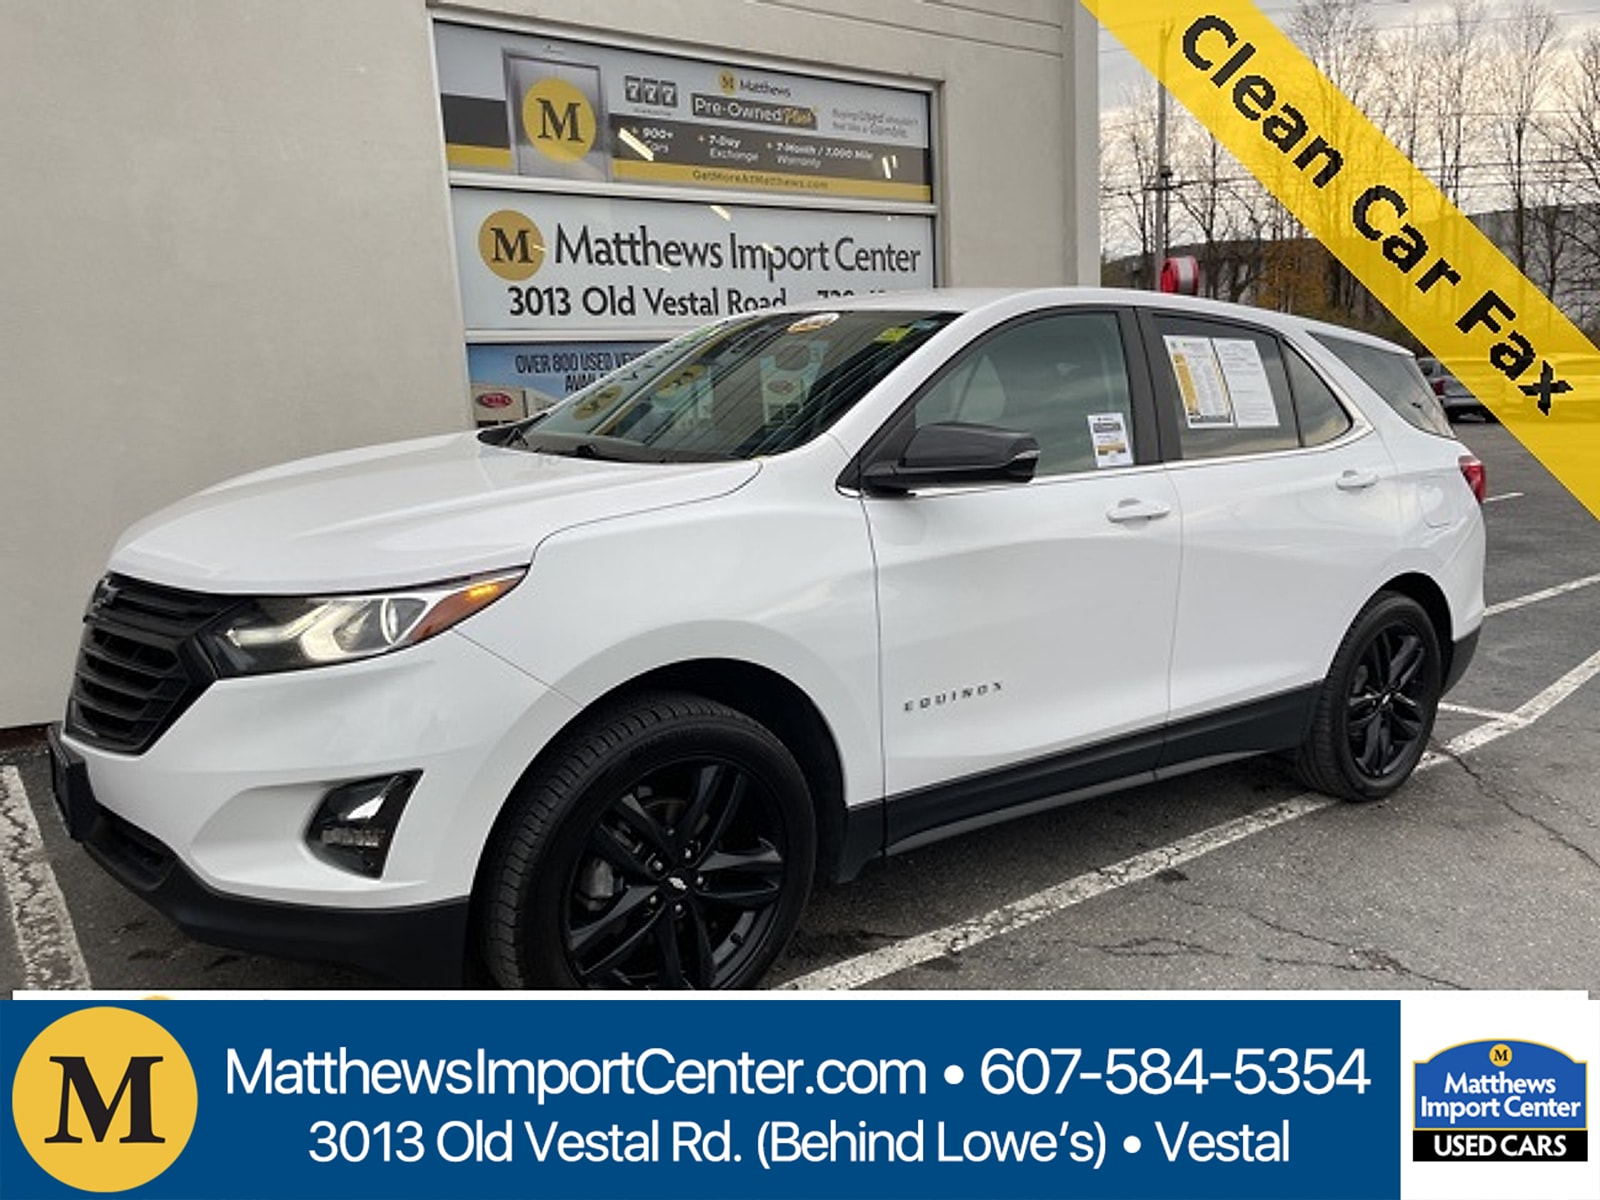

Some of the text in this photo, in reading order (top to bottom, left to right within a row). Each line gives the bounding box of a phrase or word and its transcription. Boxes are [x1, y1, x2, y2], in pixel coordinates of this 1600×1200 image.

[740, 80, 791, 98] Matthews
[536, 98, 585, 143] M
[694, 97, 781, 122] Pre-Owned
[709, 135, 741, 149] 7-Day
[709, 148, 759, 162] Exchange
[777, 156, 821, 168] Warranty
[490, 228, 533, 263] M
[555, 223, 921, 282] Matthews Import Center
[508, 285, 786, 316] 3013 Old Vestal Road
[515, 355, 550, 373] OVER
[553, 353, 578, 372] 800
[580, 352, 612, 371] USED
[904, 682, 1001, 711] EQUINOX
